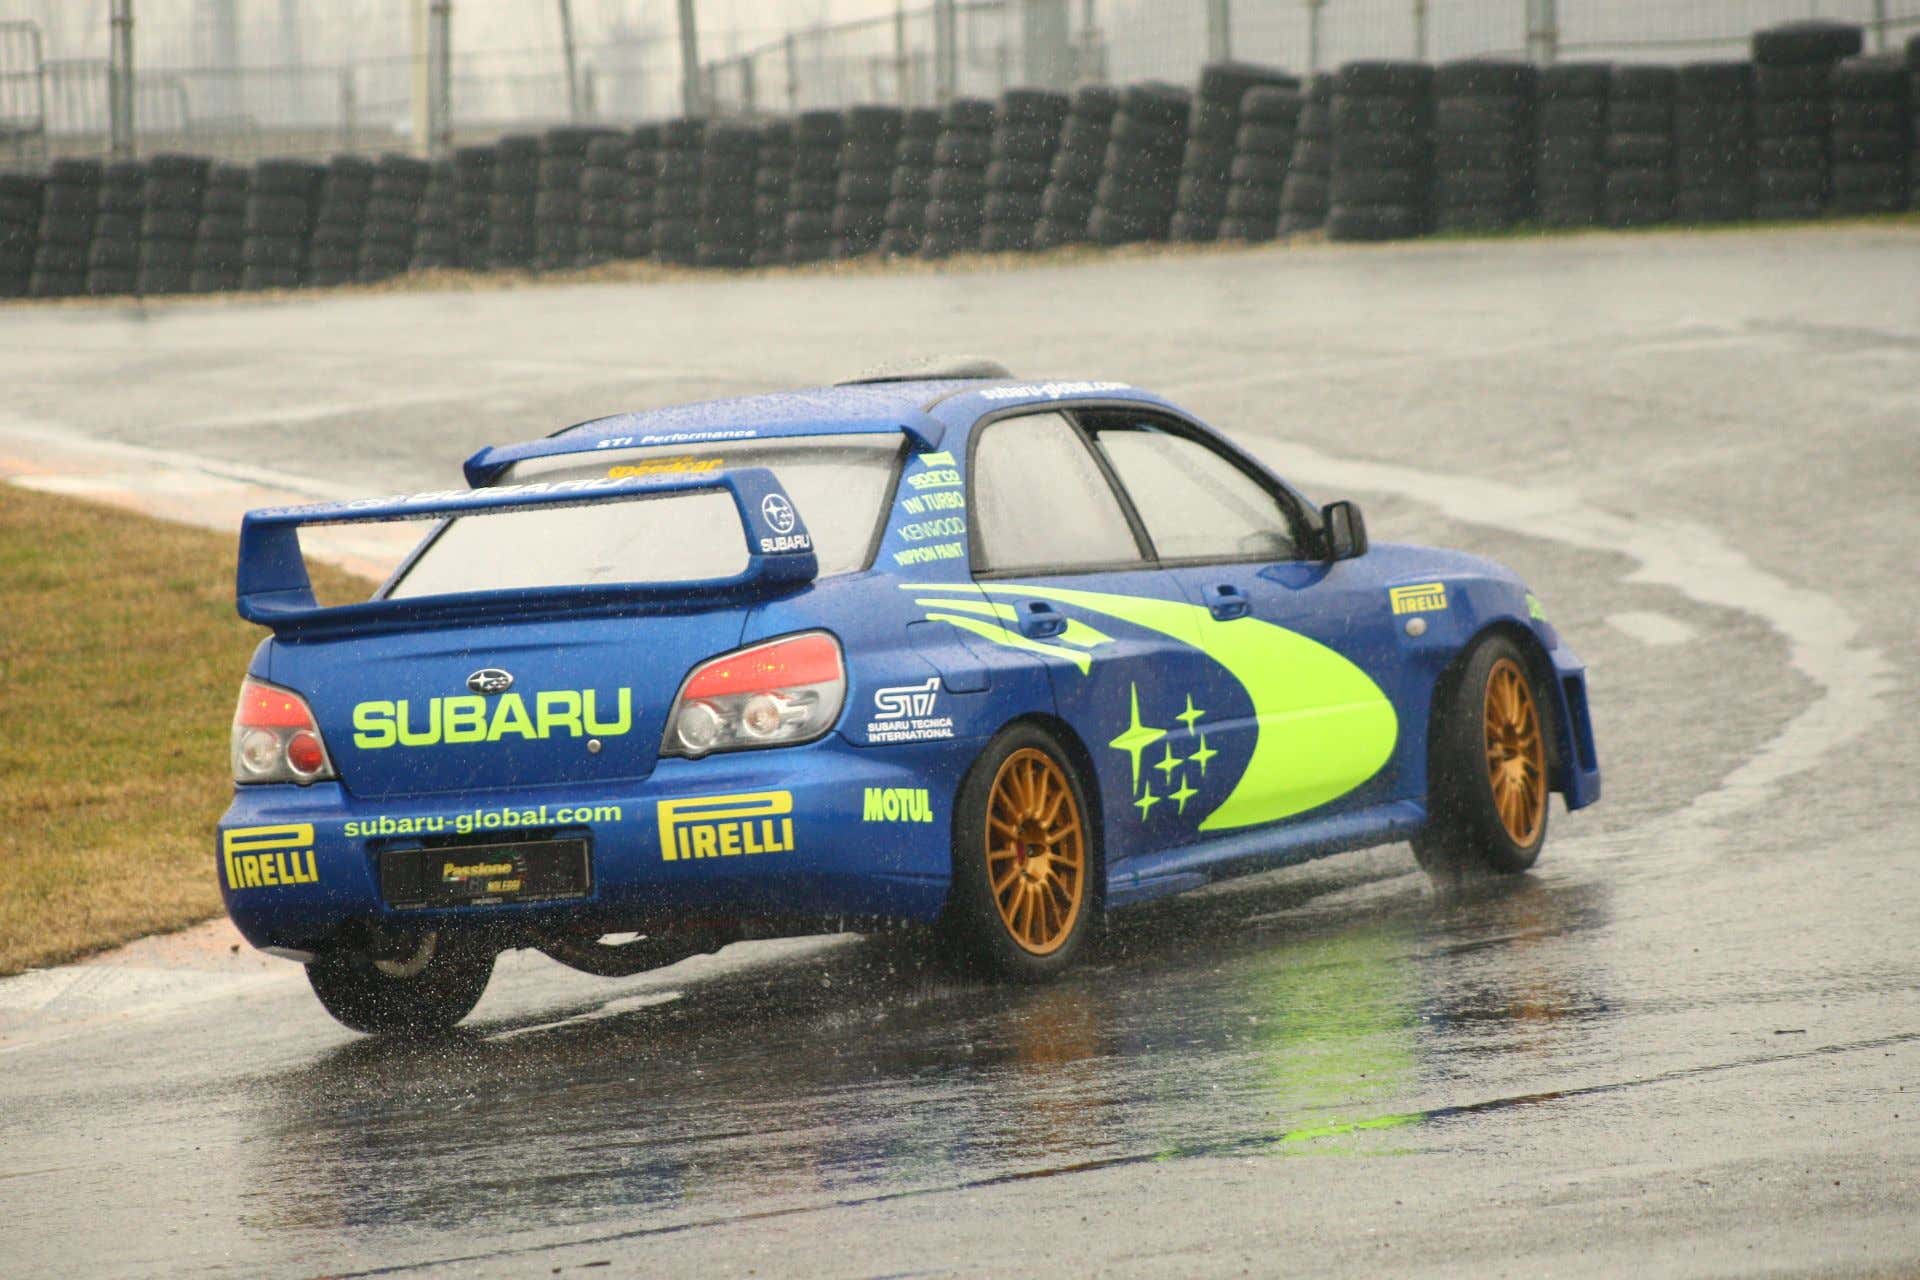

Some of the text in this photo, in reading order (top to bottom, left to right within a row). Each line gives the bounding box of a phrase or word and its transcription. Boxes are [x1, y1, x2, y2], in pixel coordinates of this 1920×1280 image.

[597, 430, 757, 449] STI Performance
[922, 491, 965, 510] TURBO
[897, 517, 966, 541] KENWOOD
[760, 534, 810, 552] SUBARU
[1389, 582, 1448, 615] PIRELLI
[353, 687, 632, 750] SUBARU
[867, 718, 953, 732] SUBARU TECNICA
[868, 729, 955, 742] INTERNATIONAL
[863, 788, 934, 823] MOTUL
[343, 806, 622, 837] subaru-global.com
[656, 790, 795, 861] PIRELLI
[223, 823, 319, 890] PIRELLI
[443, 863, 513, 877] Passione
